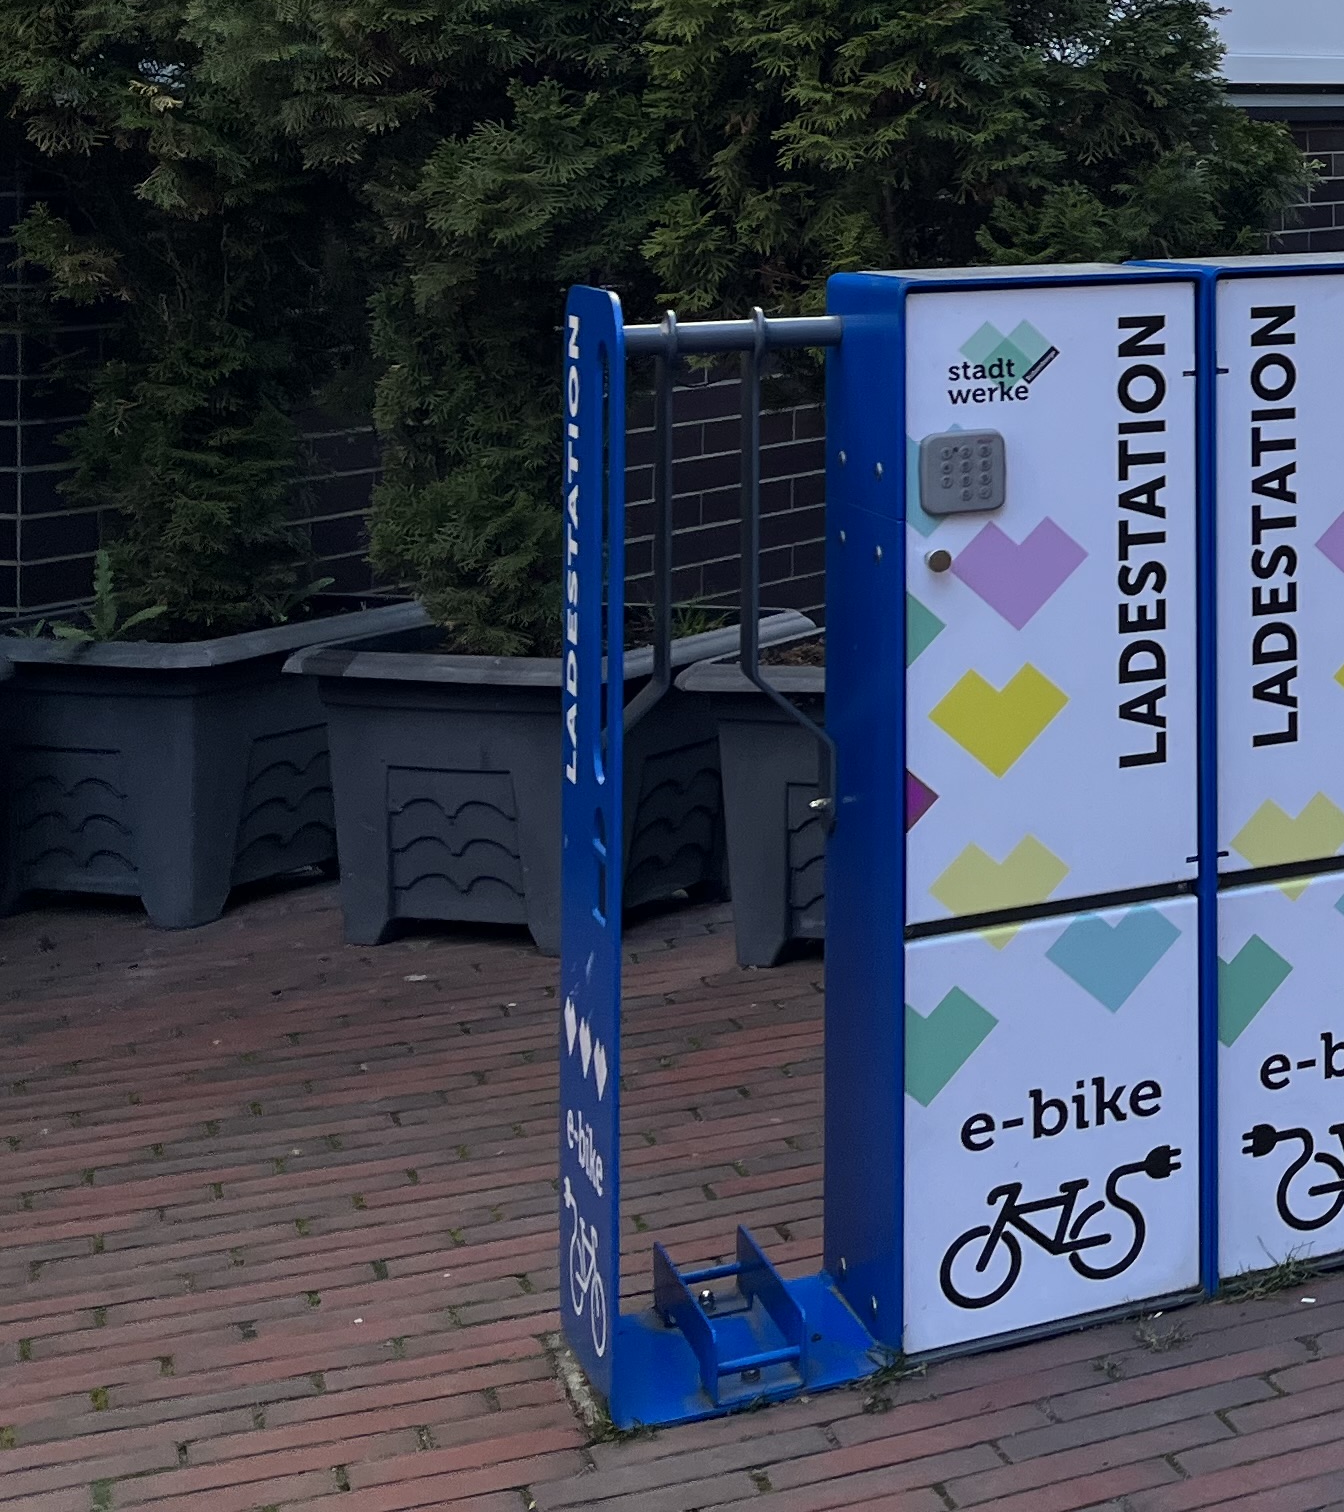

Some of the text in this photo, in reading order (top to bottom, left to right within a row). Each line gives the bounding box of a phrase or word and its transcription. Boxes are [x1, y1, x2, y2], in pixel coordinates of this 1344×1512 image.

[948, 357, 1016, 381] stadt
[948, 381, 1030, 405] werke
[564, 314, 581, 786] LADESTATION
[1116, 314, 1168, 769] LADESTATION
[1250, 304, 1299, 748] LADESTATION
[566, 1109, 604, 1197] e-bike
[959, 1075, 1163, 1152] e-bike
